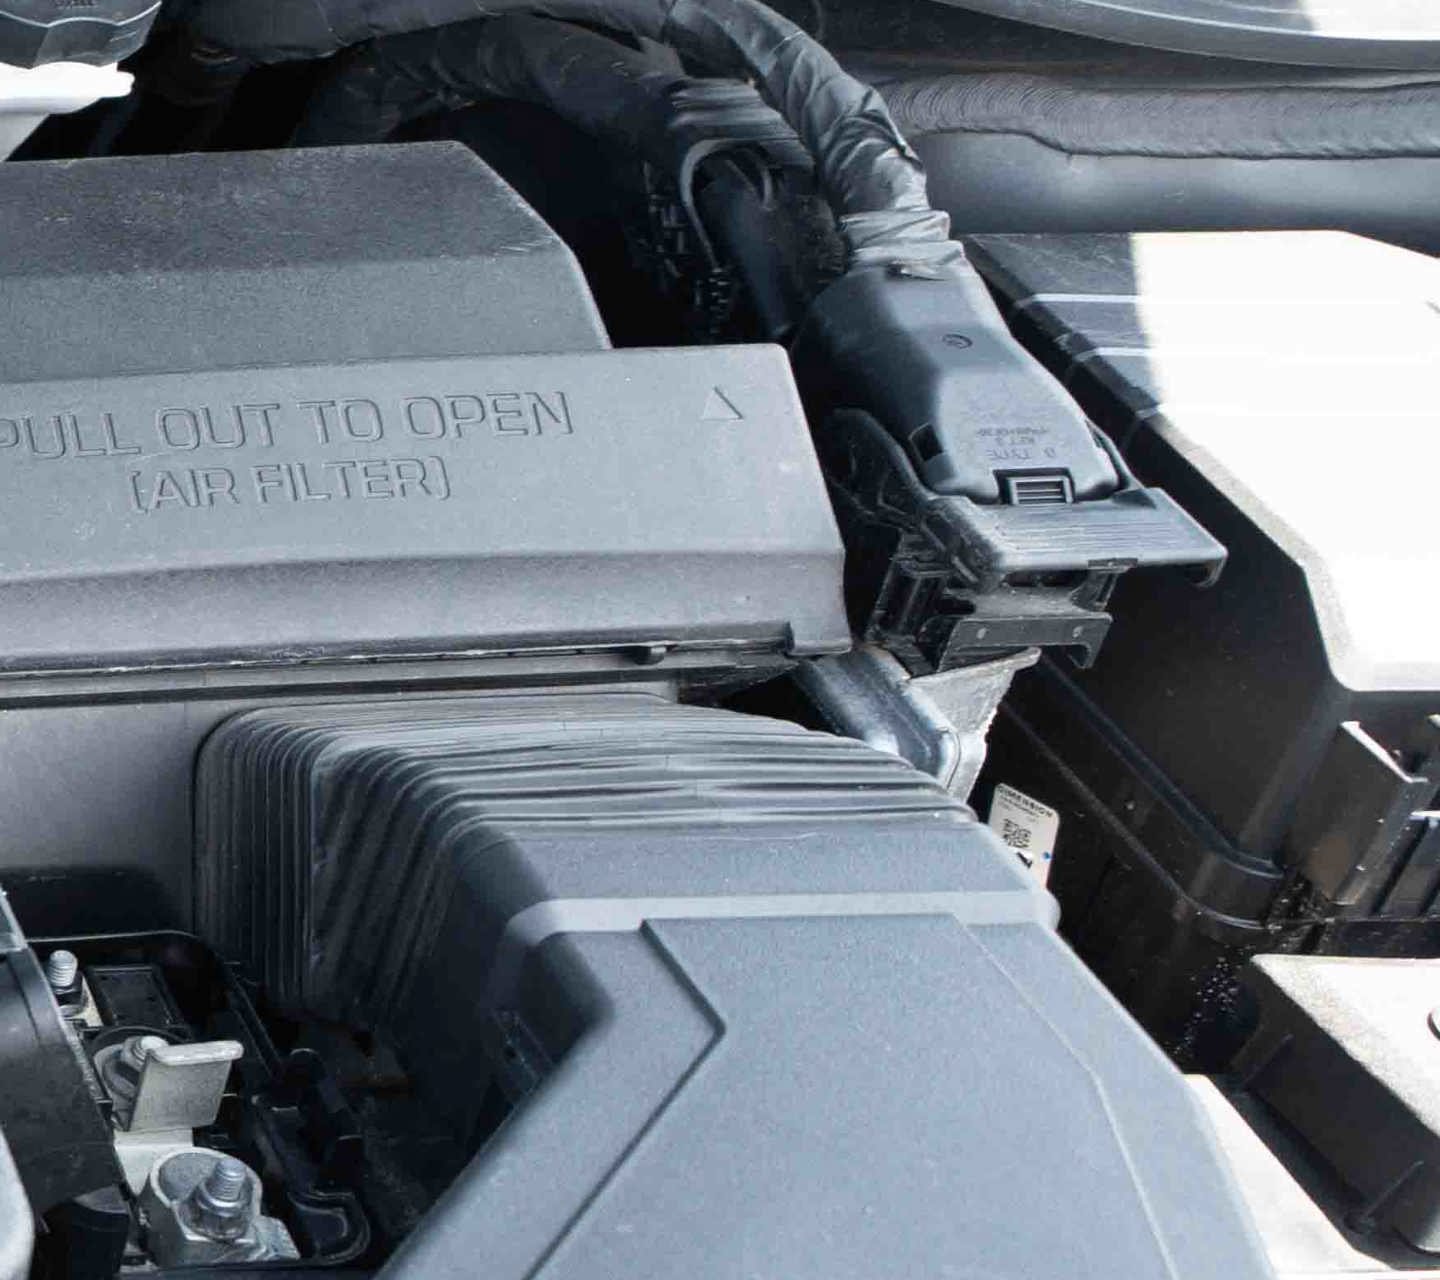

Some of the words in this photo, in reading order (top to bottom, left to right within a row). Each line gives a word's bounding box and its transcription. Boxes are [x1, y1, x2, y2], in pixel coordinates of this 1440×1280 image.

[154, 403, 281, 451] OUT
[296, 399, 385, 445] TO
[401, 391, 575, 441] OPEN
[130, 465, 242, 515] (AIR
[253, 455, 453, 505] FILTER)
